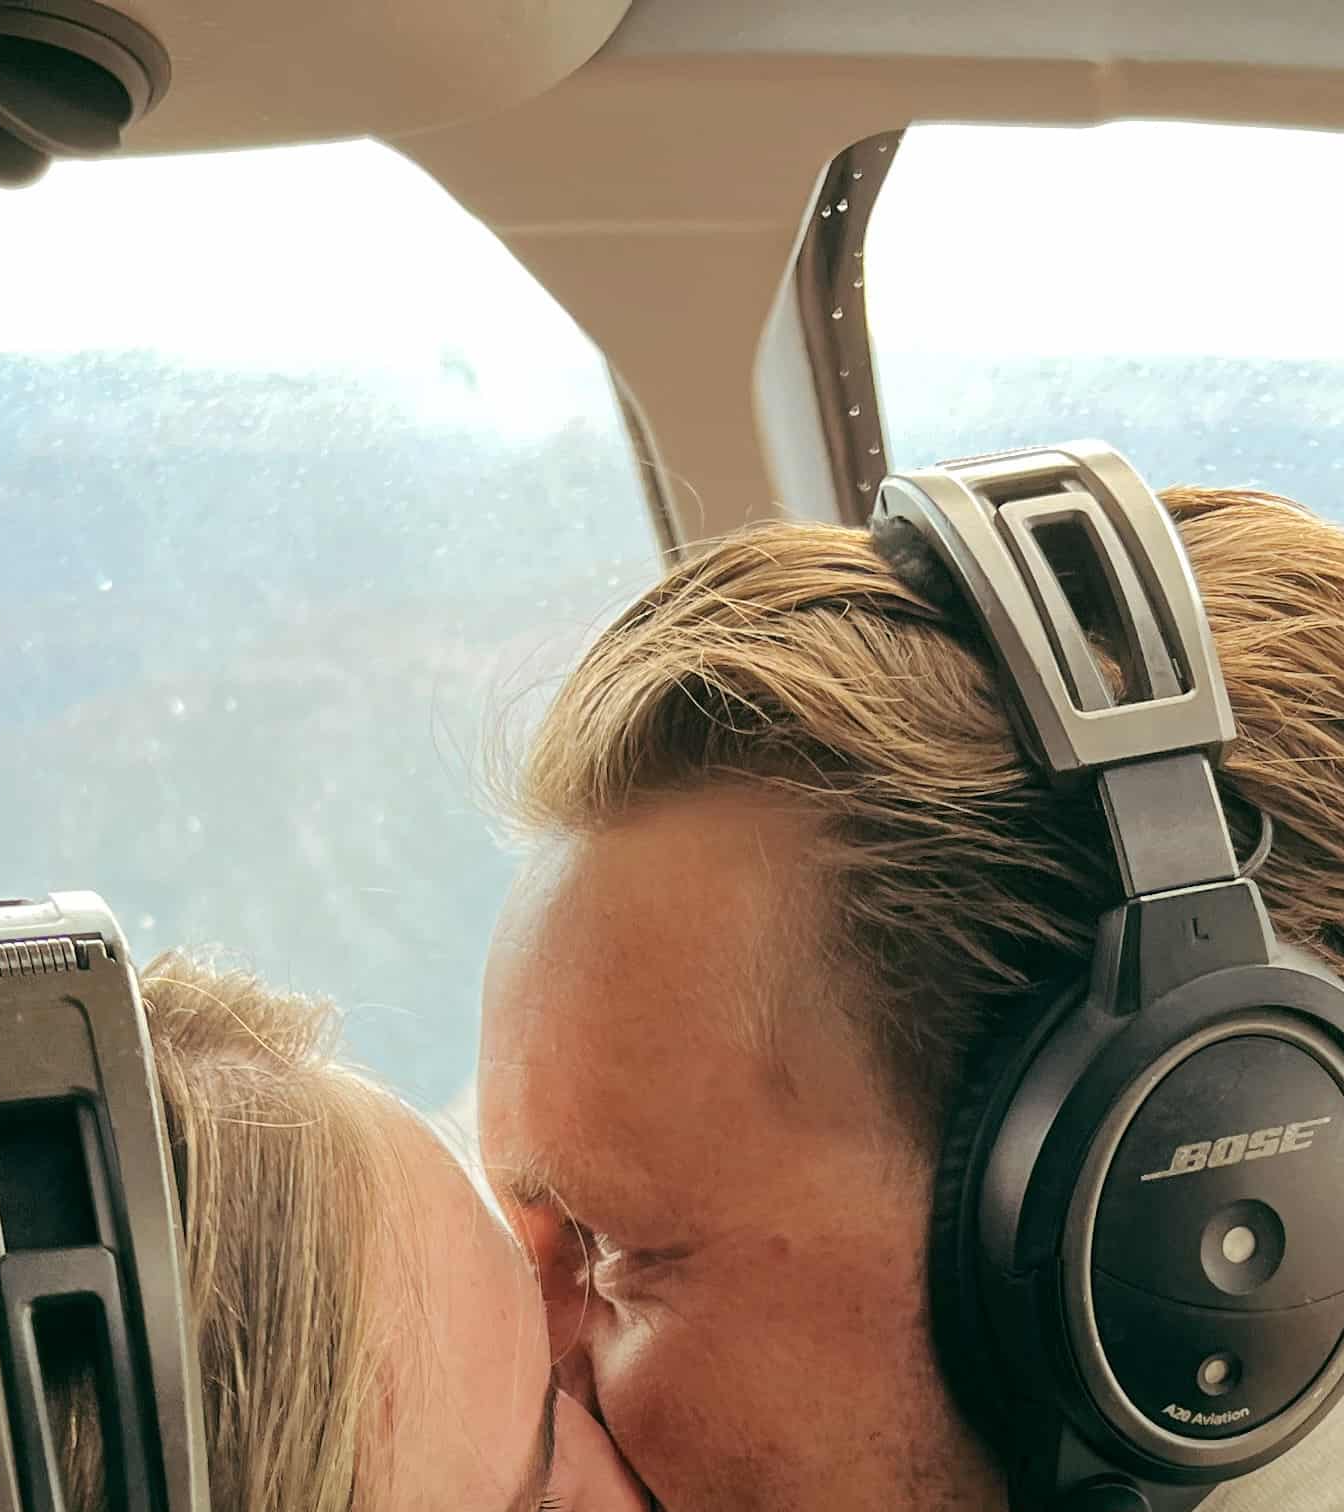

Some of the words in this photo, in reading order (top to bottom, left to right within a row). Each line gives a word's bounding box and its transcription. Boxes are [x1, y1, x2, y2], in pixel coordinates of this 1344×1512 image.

[1192, 918, 1209, 941] L
[1140, 1116, 1332, 1182] BOSE
[1161, 1404, 1192, 1422] A20
[1191, 1407, 1250, 1425] Aviation
